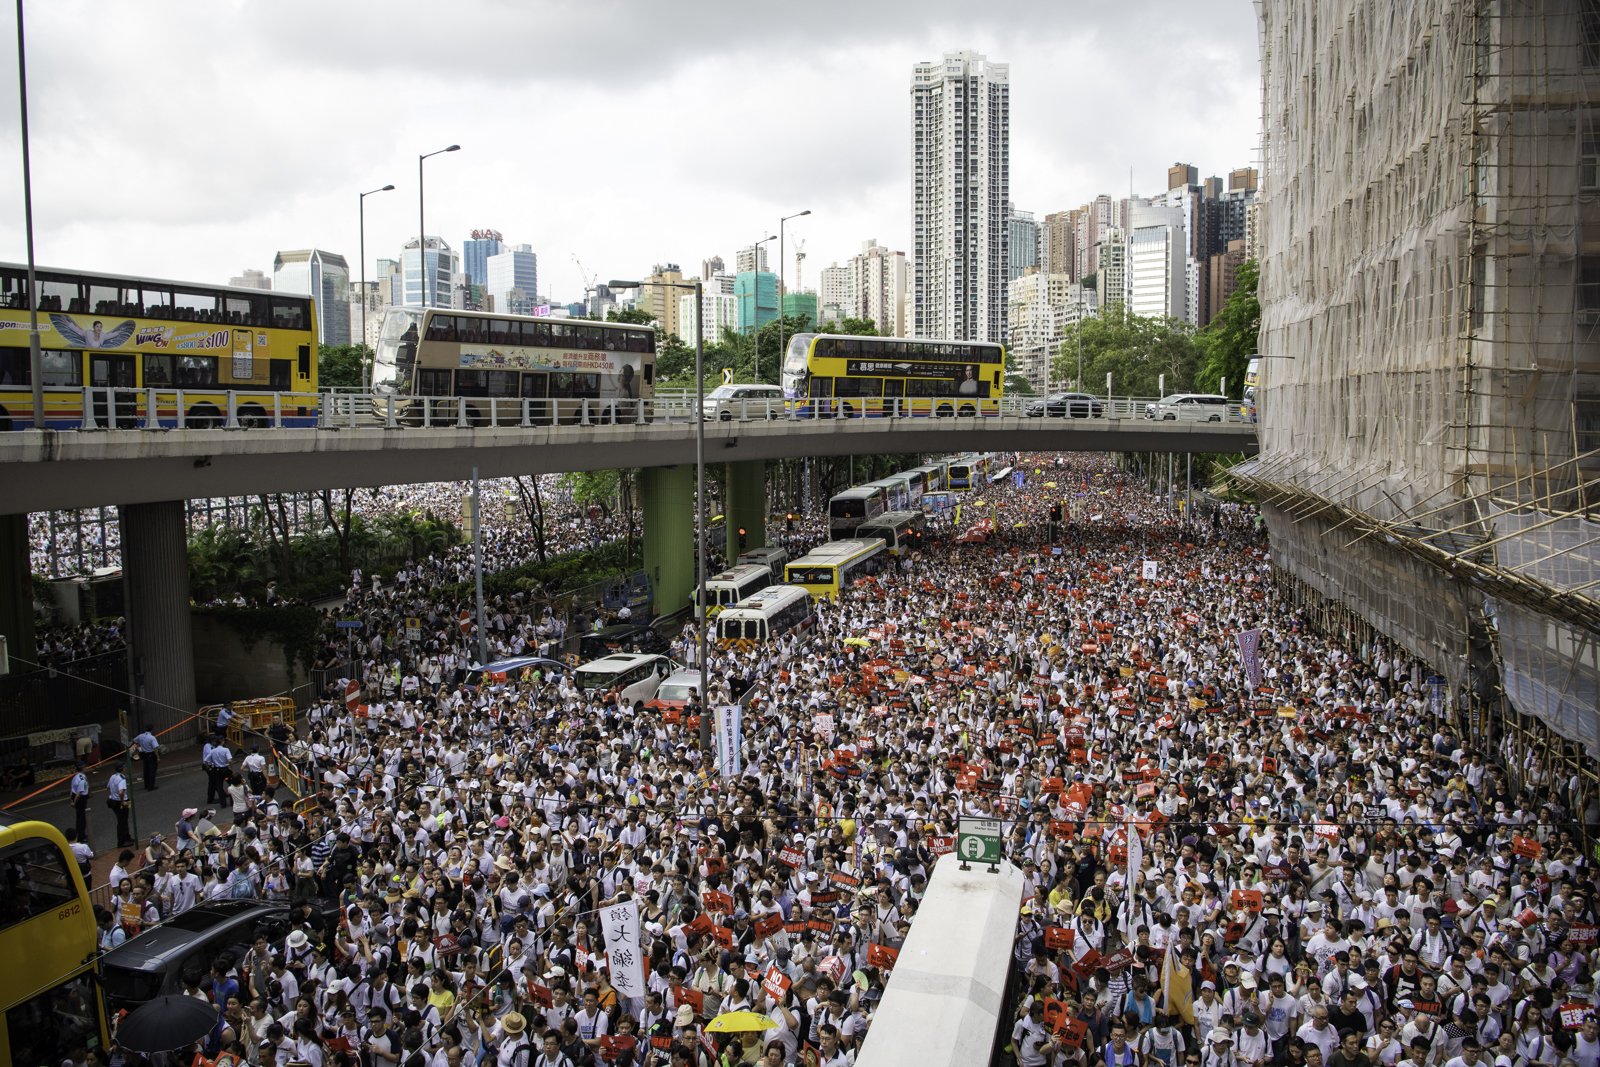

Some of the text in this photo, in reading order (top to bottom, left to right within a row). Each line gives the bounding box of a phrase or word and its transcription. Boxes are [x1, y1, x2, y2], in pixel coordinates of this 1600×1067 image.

[472, 229, 493, 238] AIA
[135, 333, 162, 346] WING
[154, 339, 169, 348] ON
[1112, 688, 1130, 699] 反送中
[1022, 697, 1039, 707] 反送中
[1159, 716, 1167, 725] NO
[932, 838, 945, 848] NO
[778, 848, 805, 867] 反送中
[1237, 899, 1258, 909] 反送中
[58, 904, 80, 921] 6812
[1569, 928, 1599, 942] 反送中
[770, 969, 784, 986] NO
[1057, 1026, 1081, 1042] 反送中
